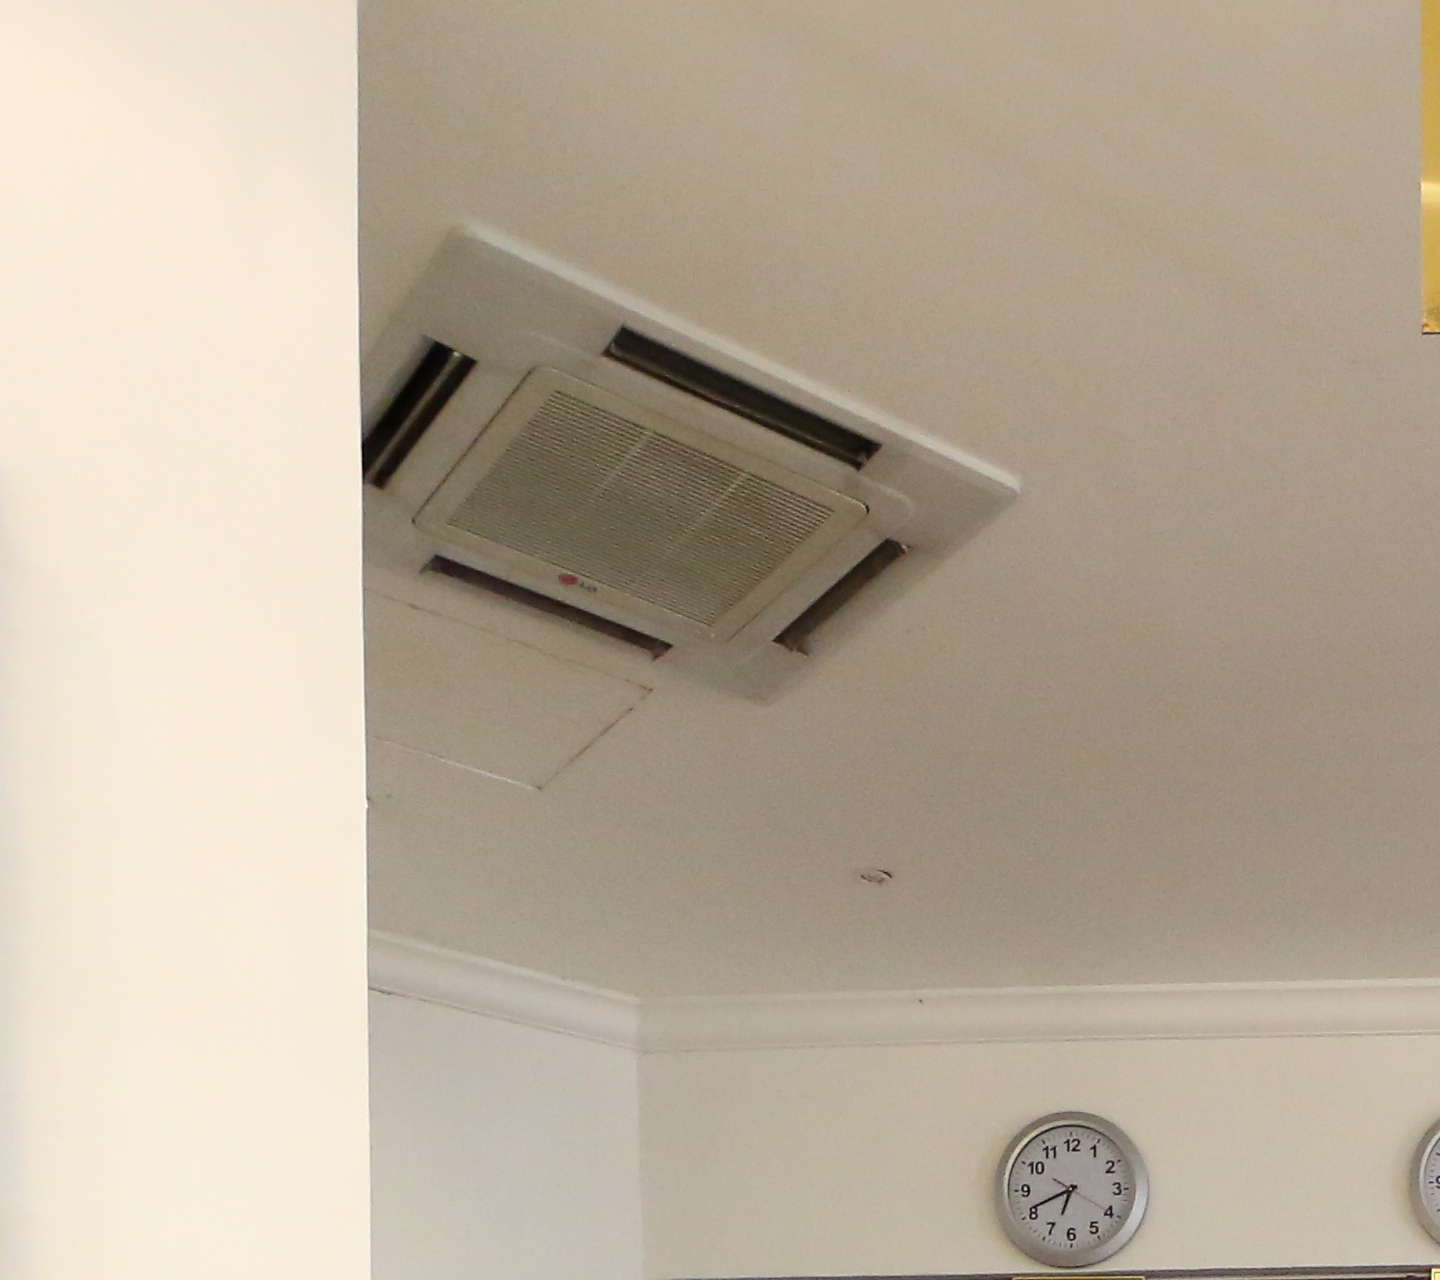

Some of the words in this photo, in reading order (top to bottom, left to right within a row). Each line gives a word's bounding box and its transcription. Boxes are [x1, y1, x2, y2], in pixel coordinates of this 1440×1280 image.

[1064, 1139, 1081, 1151] 12
[1090, 1145, 1097, 1157] 1
[1043, 1146, 1057, 1158] 11
[1028, 1162, 1044, 1174] 10
[1105, 1161, 1115, 1173] 2
[1021, 1184, 1030, 1197] 9
[1113, 1183, 1122, 1195] 3
[1029, 1208, 1038, 1220] 8
[1104, 1206, 1114, 1218] 4
[1047, 1222, 1056, 1235] 7
[1067, 1228, 1076, 1240] 6
[1089, 1222, 1099, 1235] 5
